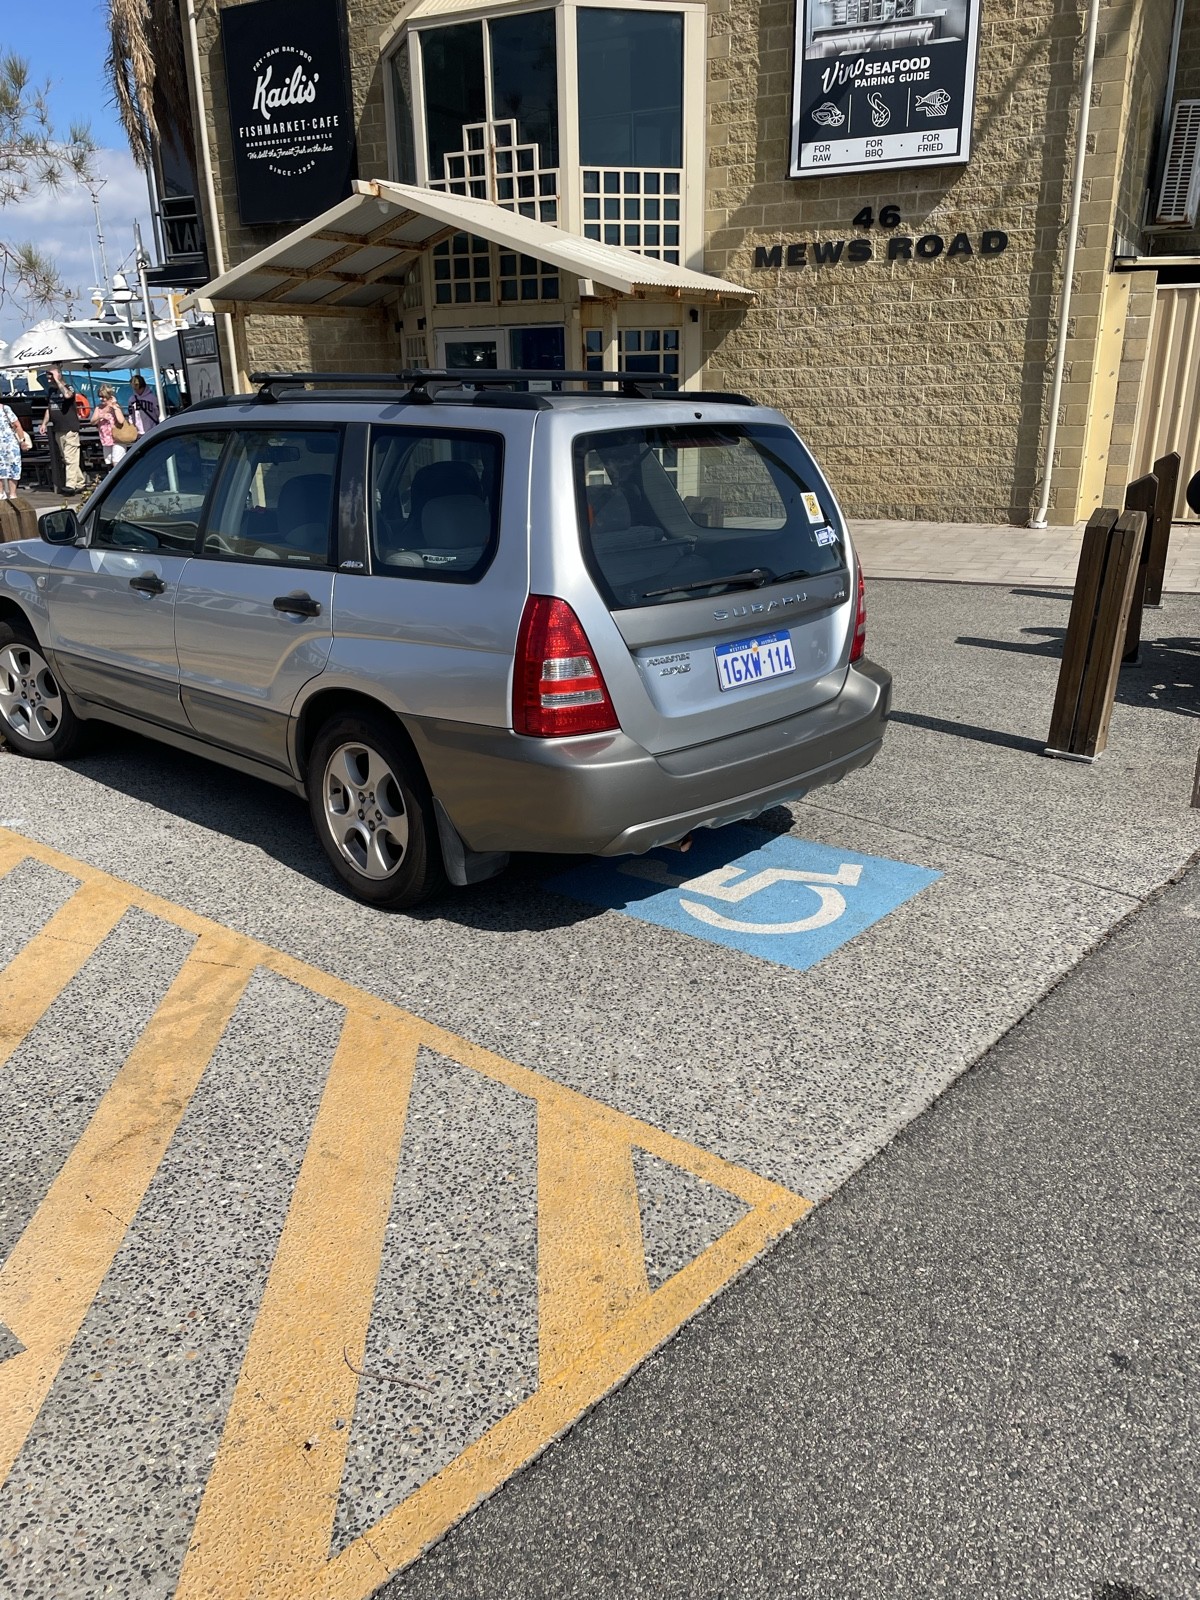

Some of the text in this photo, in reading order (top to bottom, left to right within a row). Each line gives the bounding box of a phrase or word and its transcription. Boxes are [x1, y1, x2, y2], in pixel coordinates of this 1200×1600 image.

[266, 47, 280, 58] RAW
[299, 50, 313, 63] BBQ
[821, 56, 931, 94] Vino SEAFOOD
[854, 71, 931, 88] PAIRING GUIDE
[294, 132, 333, 142] FREMANTLE
[922, 133, 940, 143] FOR
[814, 144, 831, 153] FOR
[865, 139, 883, 148] FOR
[917, 143, 944, 153] FRIED
[812, 153, 832, 163] RAW
[865, 148, 884, 158] BBQ
[269, 164, 292, 177] SINCE
[852, 204, 901, 229] 46
[754, 230, 1009, 268] MEWS ROAD
[713, 592, 808, 621] SUBARU
[729, 645, 748, 653] WESTERN
